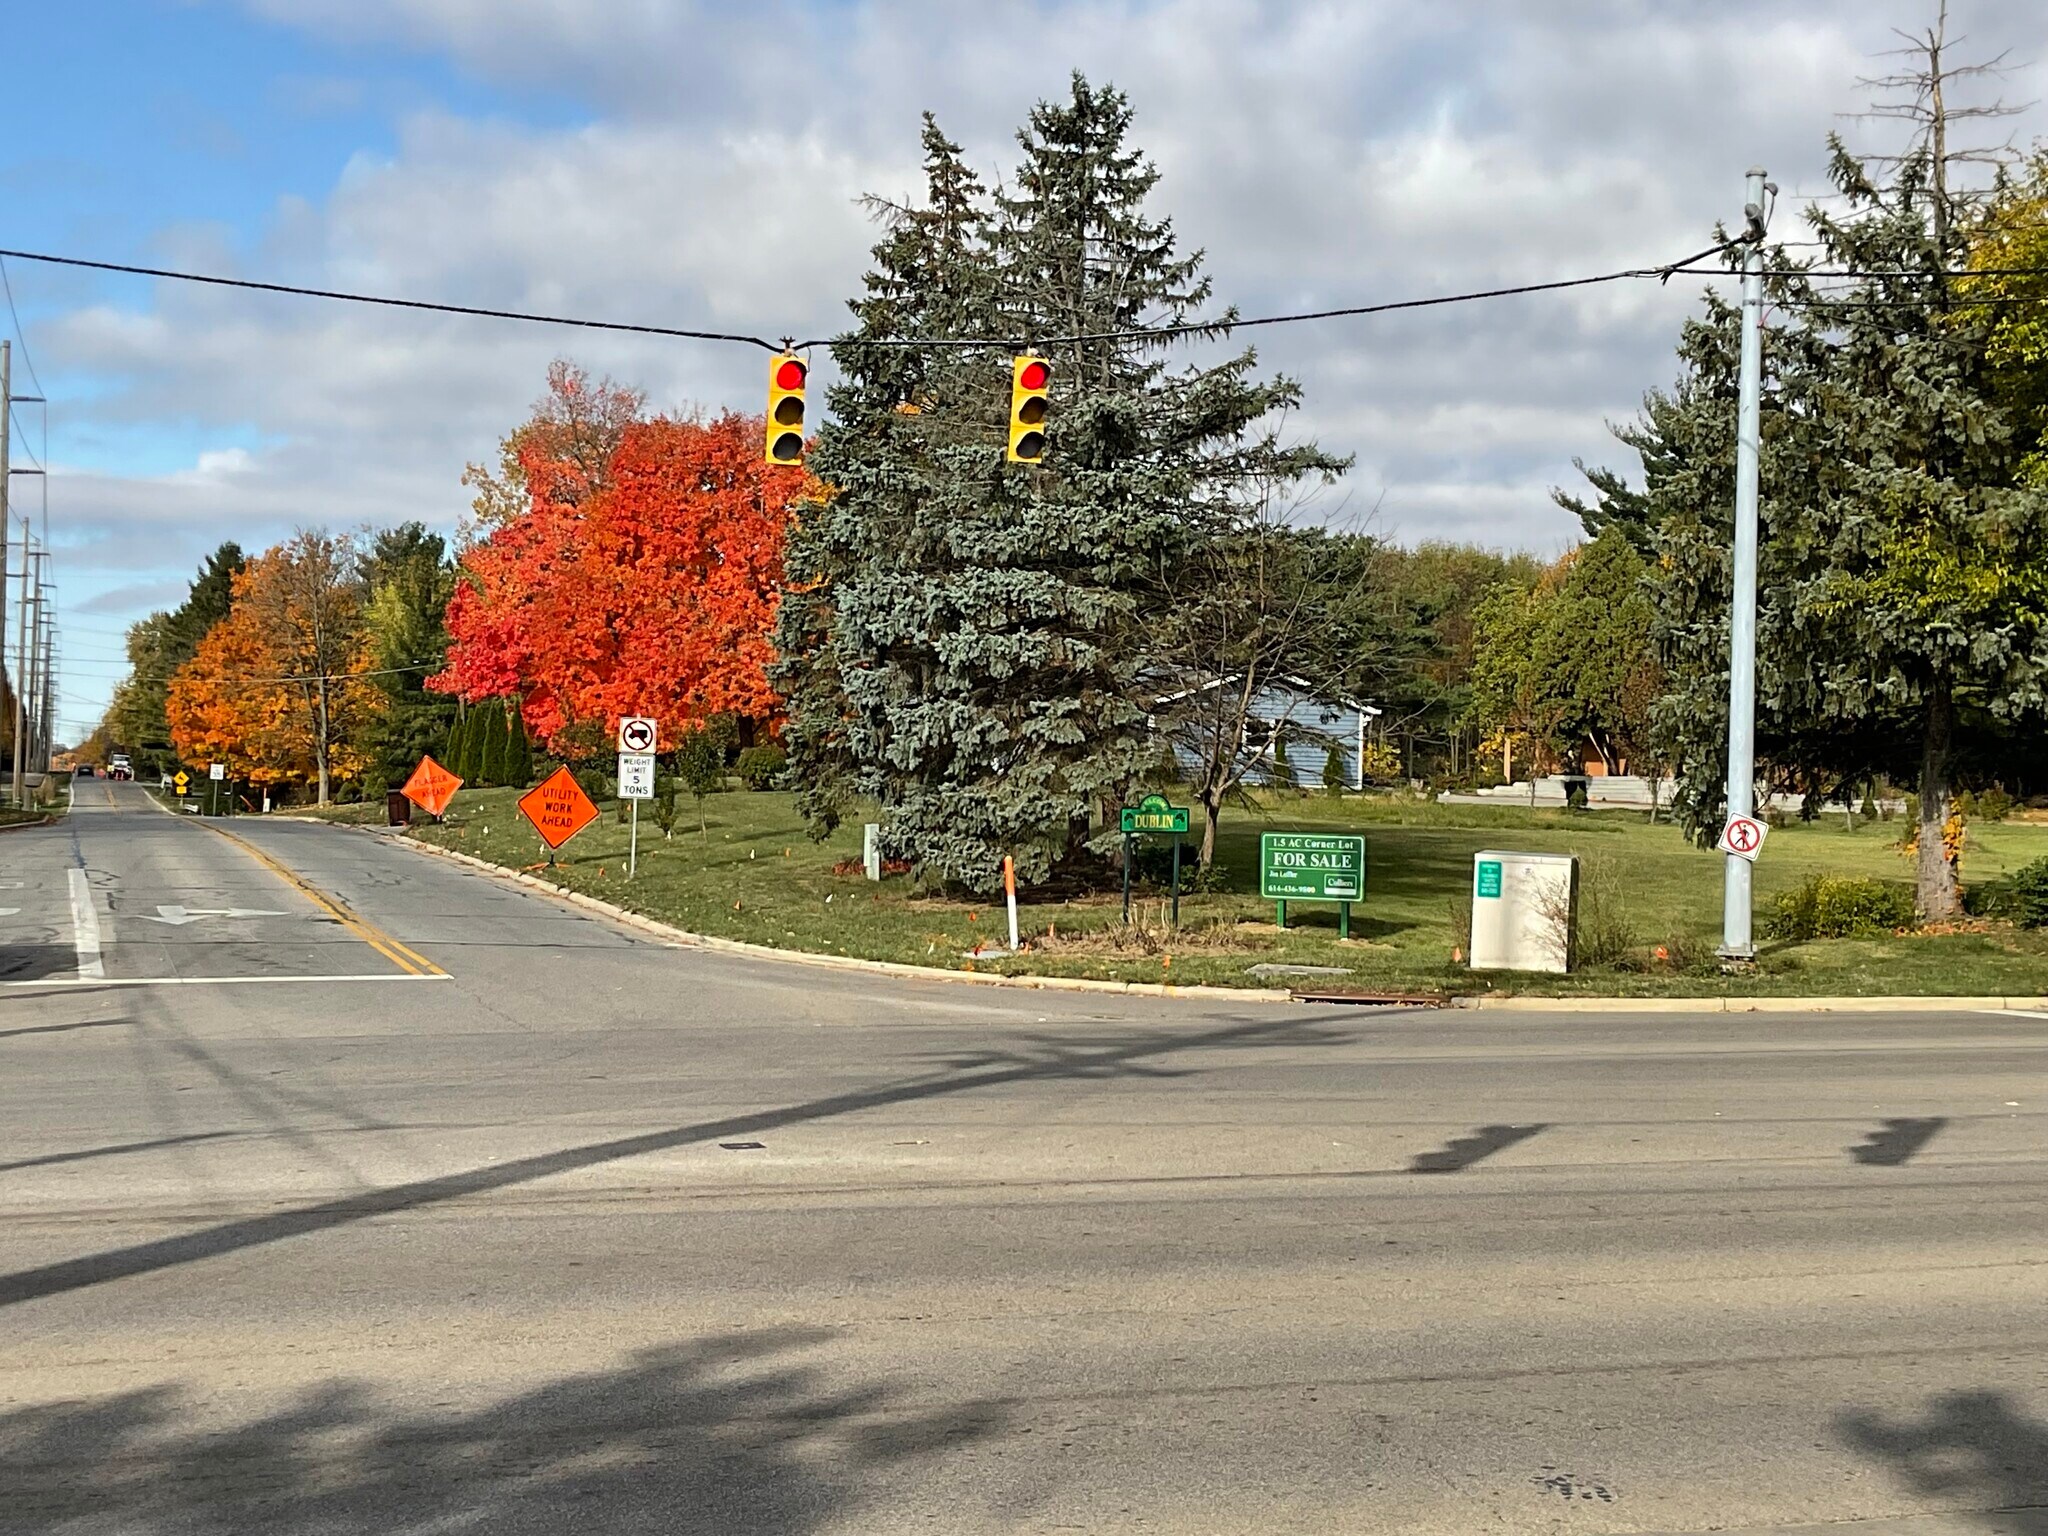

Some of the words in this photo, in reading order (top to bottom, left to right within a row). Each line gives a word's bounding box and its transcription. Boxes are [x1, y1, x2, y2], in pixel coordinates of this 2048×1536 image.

[623, 758, 651, 766] WEIGHT
[626, 766, 647, 774] LIMIT
[632, 775, 640, 784] 5
[542, 787, 579, 801] UTILITY
[623, 785, 649, 795] TONS
[545, 801, 573, 814] WORK
[541, 815, 573, 828] AHEAD
[1134, 814, 1174, 829] DUBLIN
[1273, 838, 1286, 848] 1.5
[1288, 839, 1302, 848] AC
[1304, 839, 1336, 849] Corner
[1338, 840, 1354, 849] Lot
[1273, 852, 1307, 867] FOR
[1310, 853, 1352, 868] SALE
